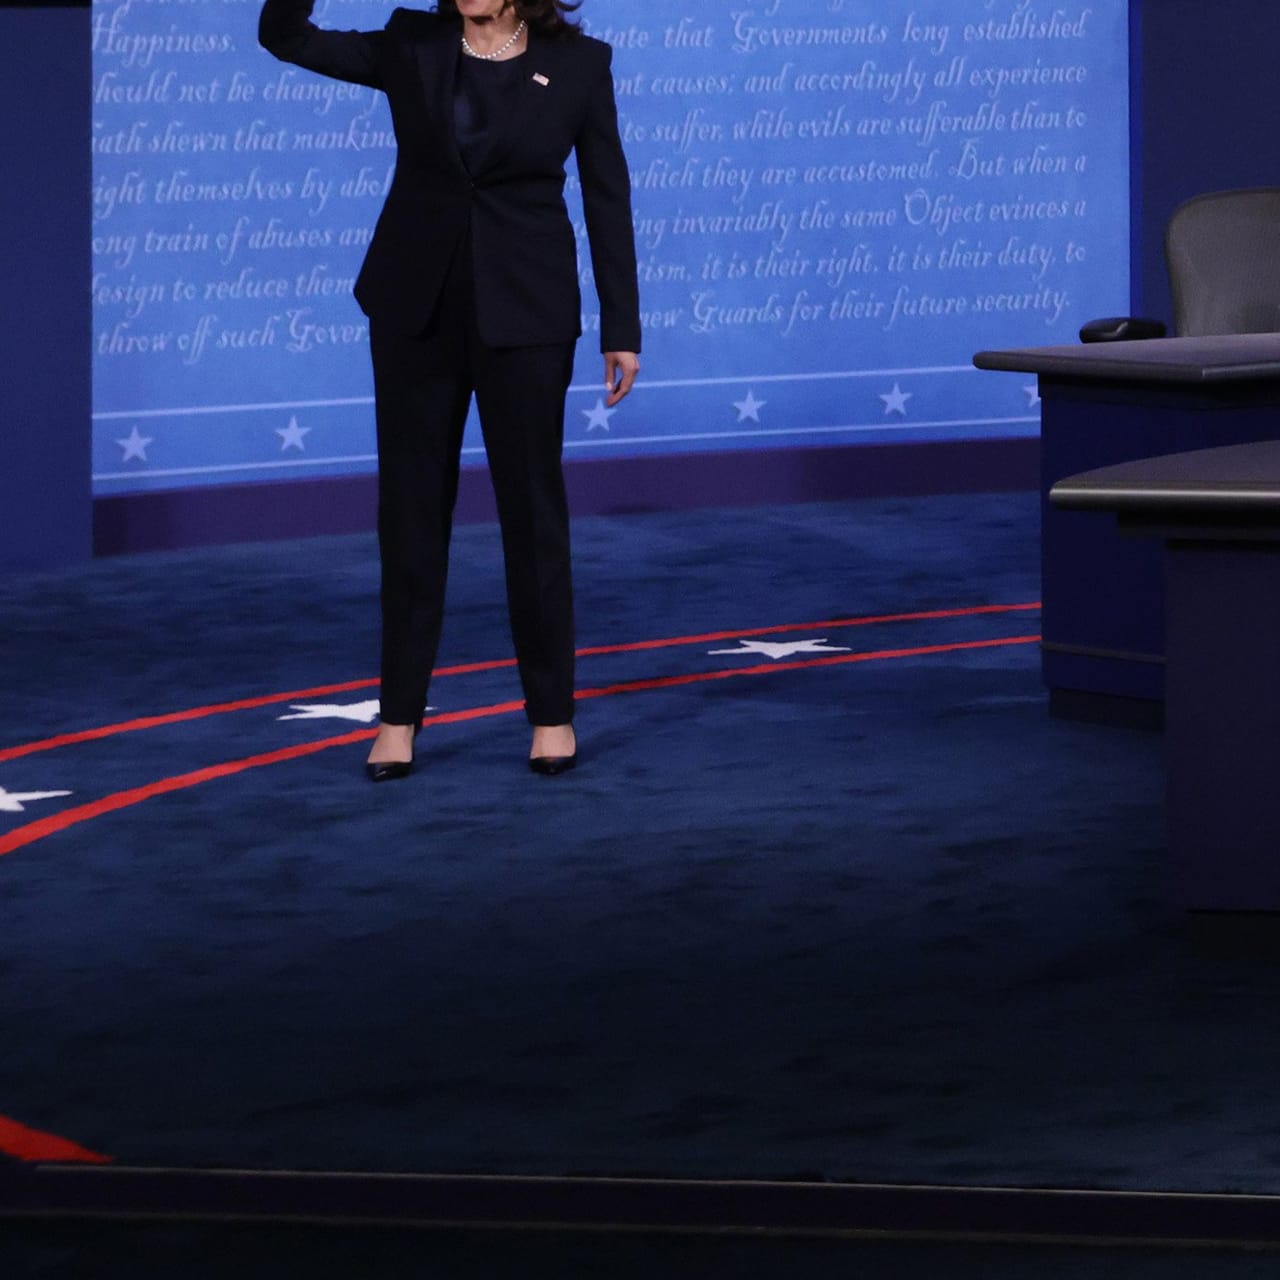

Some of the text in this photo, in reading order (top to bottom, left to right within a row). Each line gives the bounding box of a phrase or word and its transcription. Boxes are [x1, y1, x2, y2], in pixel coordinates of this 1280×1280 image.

[664, 17, 714, 50] that
[730, 10, 889, 55] Governments
[901, 11, 950, 56] long
[963, 8, 1093, 40] established
[178, 55, 1088, 104] not be and accordingly all experience
[147, 99, 1087, 153] shewn that to while evils are sufferable than to
[154, 137, 1067, 217] themselves by they are But when
[144, 222, 209, 253] train
[215, 215, 251, 266] of
[248, 218, 333, 250] abuses
[672, 199, 795, 246] invariably
[800, 199, 835, 230] the
[840, 207, 898, 228] same
[903, 188, 983, 237] Object
[989, 194, 1070, 221] evinces
[171, 278, 199, 302] to
[203, 267, 289, 300] reduce
[701, 252, 723, 280] it
[727, 251, 748, 280] is
[754, 245, 811, 278] their
[887, 244, 907, 271] it
[912, 243, 932, 270] is
[938, 237, 993, 268] their
[1065, 241, 1087, 263] to
[97, 284, 967, 366] throw off such Guards for their future
